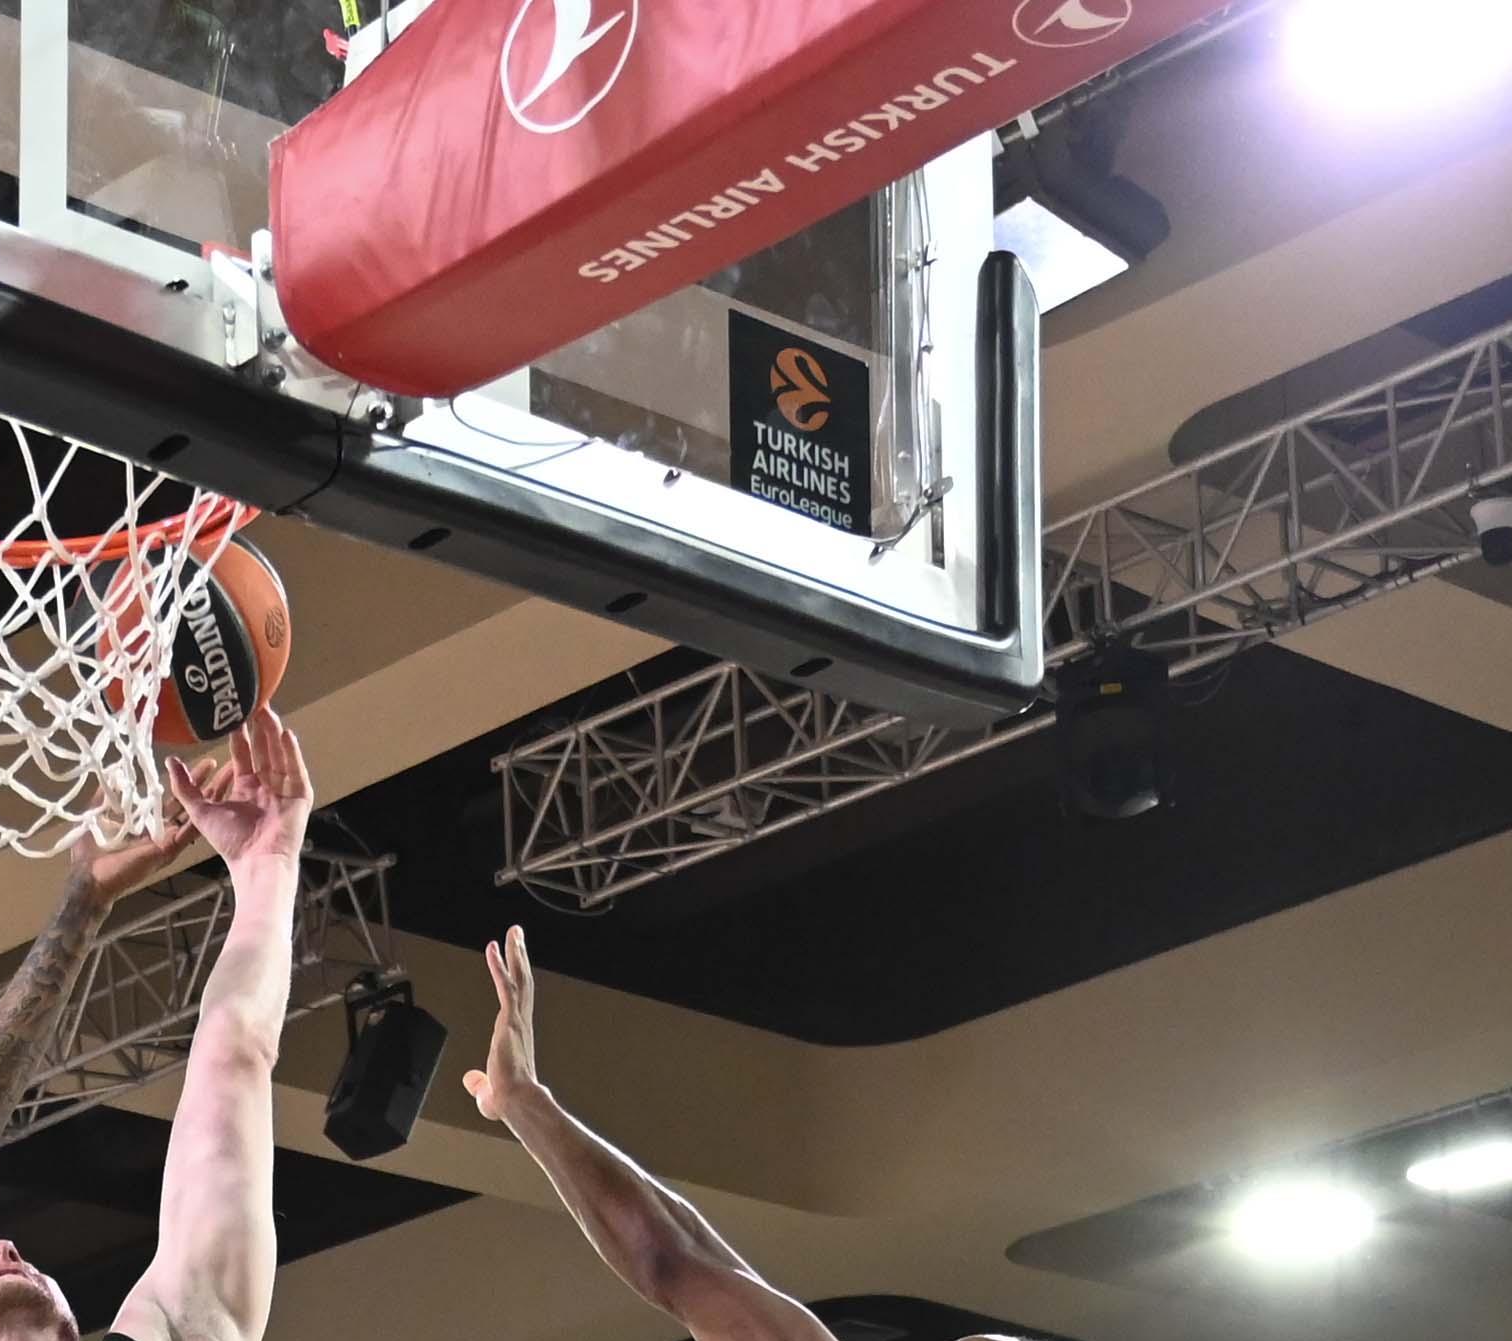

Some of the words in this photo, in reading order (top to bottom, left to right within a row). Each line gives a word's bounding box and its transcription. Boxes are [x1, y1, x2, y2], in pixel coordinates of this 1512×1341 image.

[786, 50, 1018, 173] TURKISH
[578, 167, 786, 284] AIRLINES
[752, 449, 851, 505] AIRLINES
[753, 421, 849, 479] TURKISH
[750, 474, 853, 530] EuroLeague
